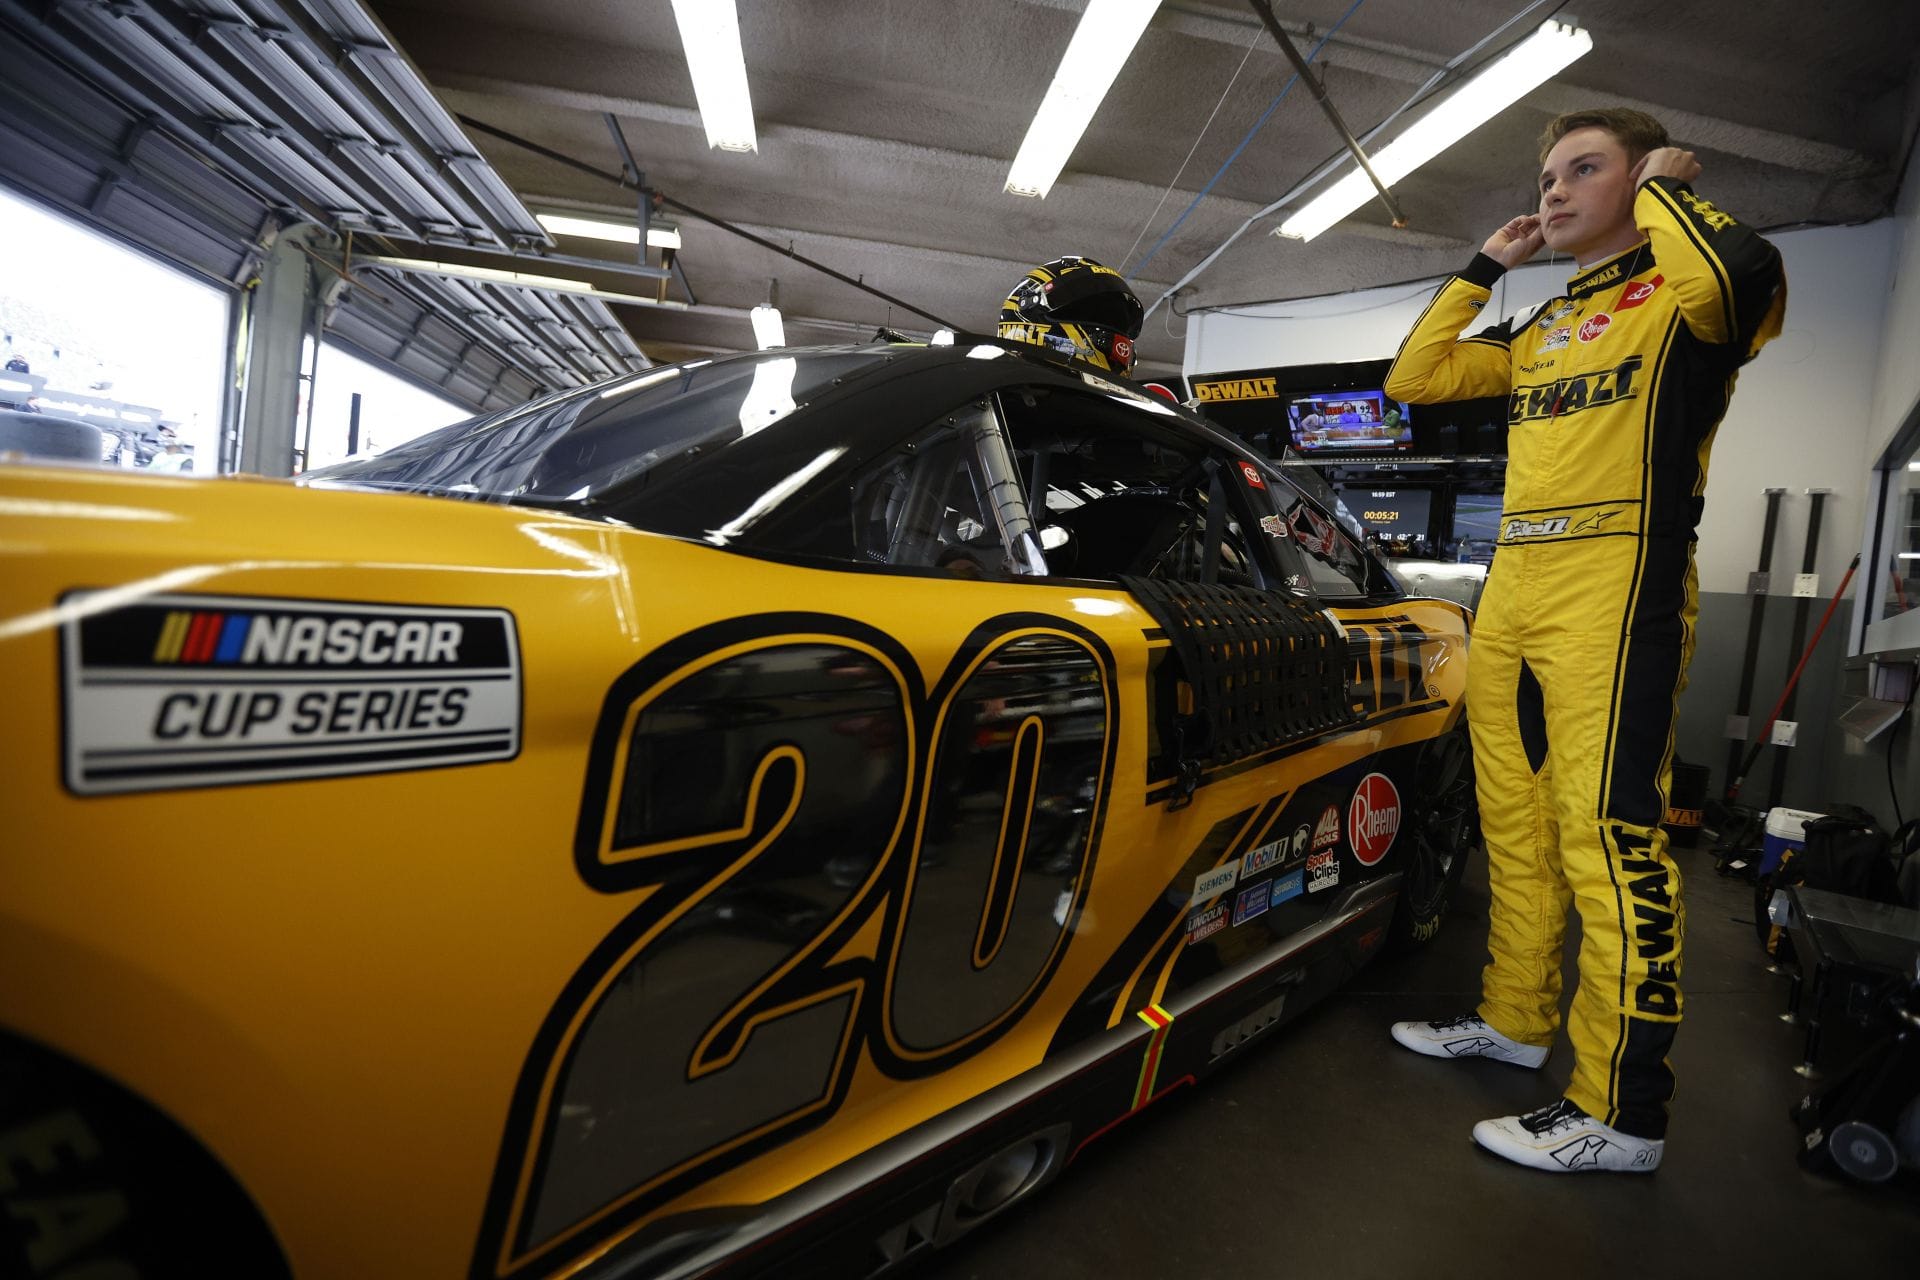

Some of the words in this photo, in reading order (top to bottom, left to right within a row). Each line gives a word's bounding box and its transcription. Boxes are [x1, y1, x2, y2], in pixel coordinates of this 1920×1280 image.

[999, 323, 1051, 346] WALT
[1195, 378, 1277, 401] DEWALT
[1363, 511, 1399, 520] 00:05:21
[241, 614, 464, 664] NASCAR
[152, 692, 282, 740] CUP
[289, 686, 471, 735] SERIES
[1355, 779, 1397, 850] Rheem
[1313, 831, 1339, 849] TOOLS
[1245, 844, 1275, 873] Mobil
[1307, 850, 1333, 870] Sport
[1314, 860, 1339, 882] Clips
[1198, 870, 1234, 897] SIEMENS
[1187, 905, 1226, 931] LINCOLN
[1192, 917, 1226, 942] WELDERS
[1611, 825, 1680, 1016] DEWALT
[472, 610, 1120, 1280] 20
[1630, 1148, 1657, 1167] 20
[0, 1105, 145, 1280] EA
